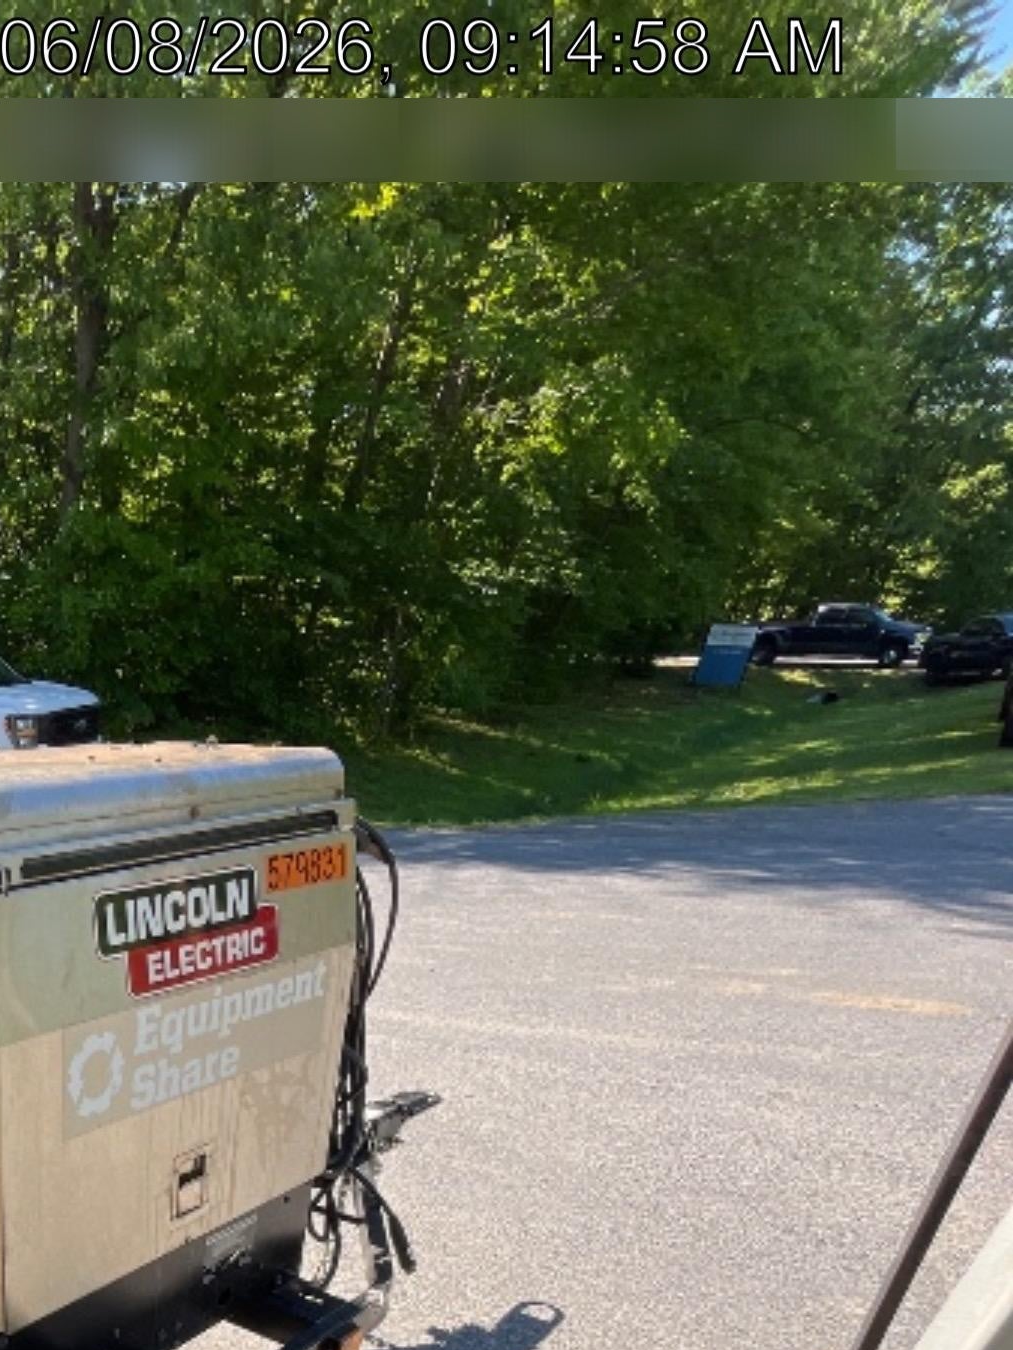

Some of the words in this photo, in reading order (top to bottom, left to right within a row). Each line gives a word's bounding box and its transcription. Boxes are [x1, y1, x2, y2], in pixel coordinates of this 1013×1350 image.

[267, 843, 345, 890] 579831
[105, 878, 250, 946] LINCOLN
[146, 926, 267, 985] ELECTRIC
[133, 959, 327, 1056] Equipment
[130, 1046, 241, 1110] Share
